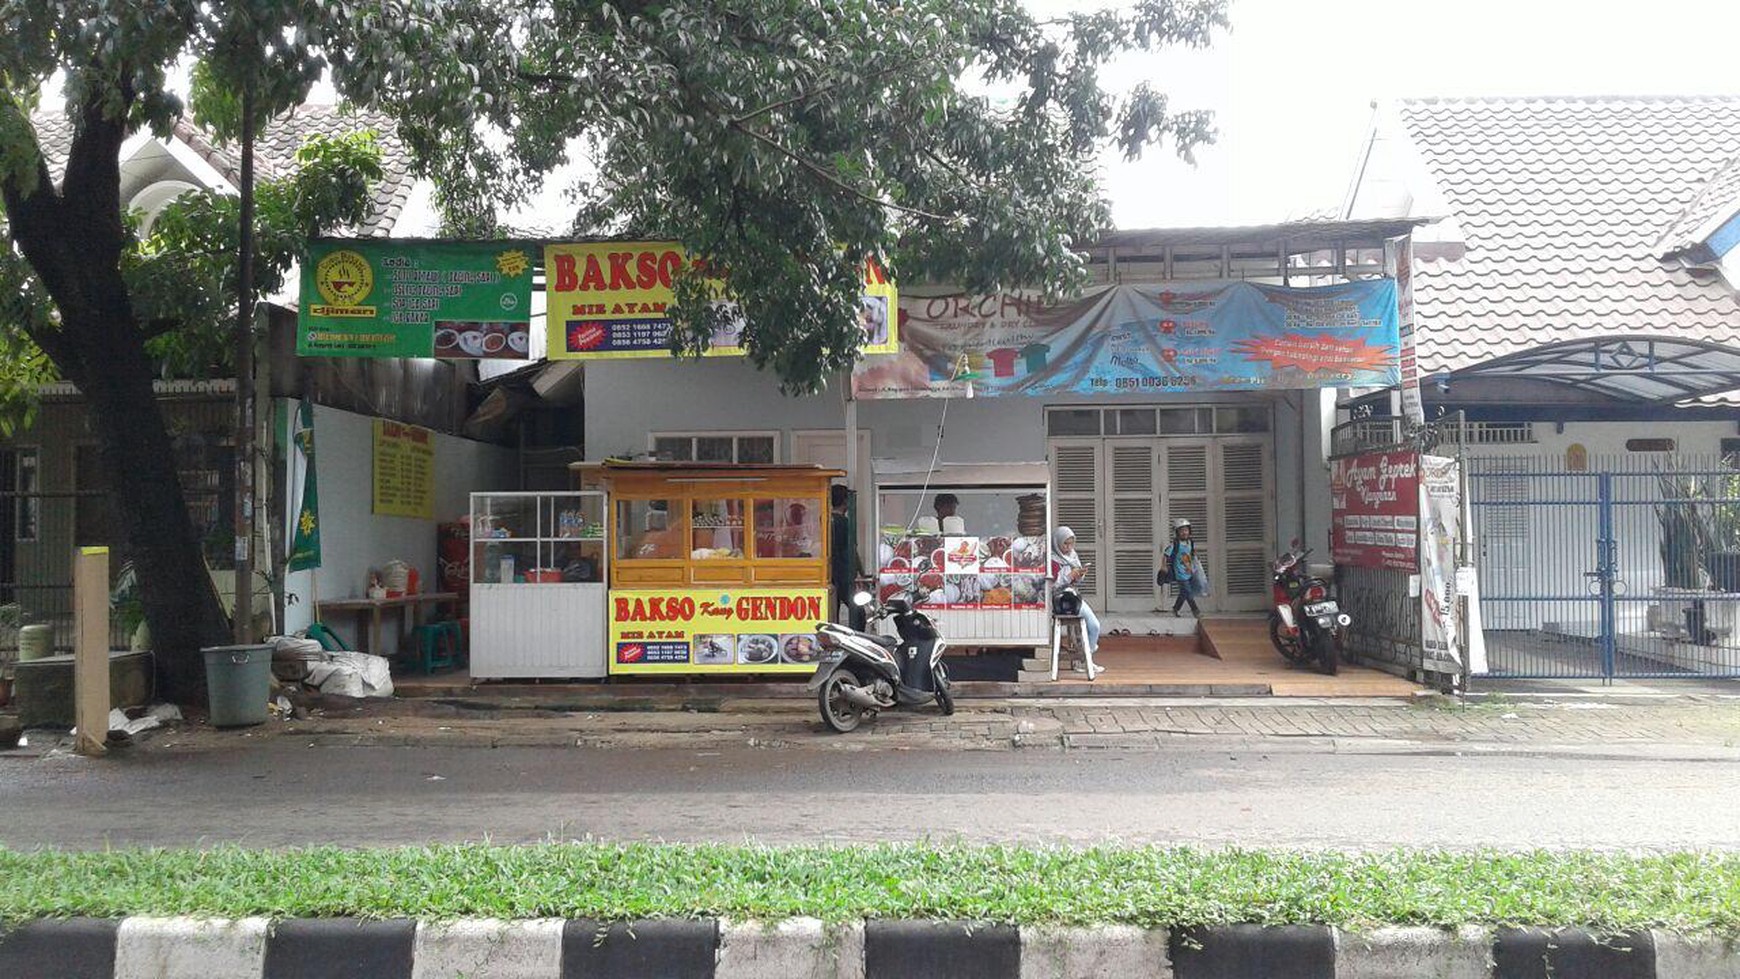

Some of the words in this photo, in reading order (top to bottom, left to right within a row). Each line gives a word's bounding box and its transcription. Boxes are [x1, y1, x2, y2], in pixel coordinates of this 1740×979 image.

[553, 251, 681, 293] BAKSO
[571, 303, 606, 316] MIE
[611, 302, 667, 315] AYAM
[614, 596, 695, 622] BAKSO
[699, 601, 734, 620] Kang
[736, 596, 822, 621] GENDON
[646, 630, 685, 639] AYAM
